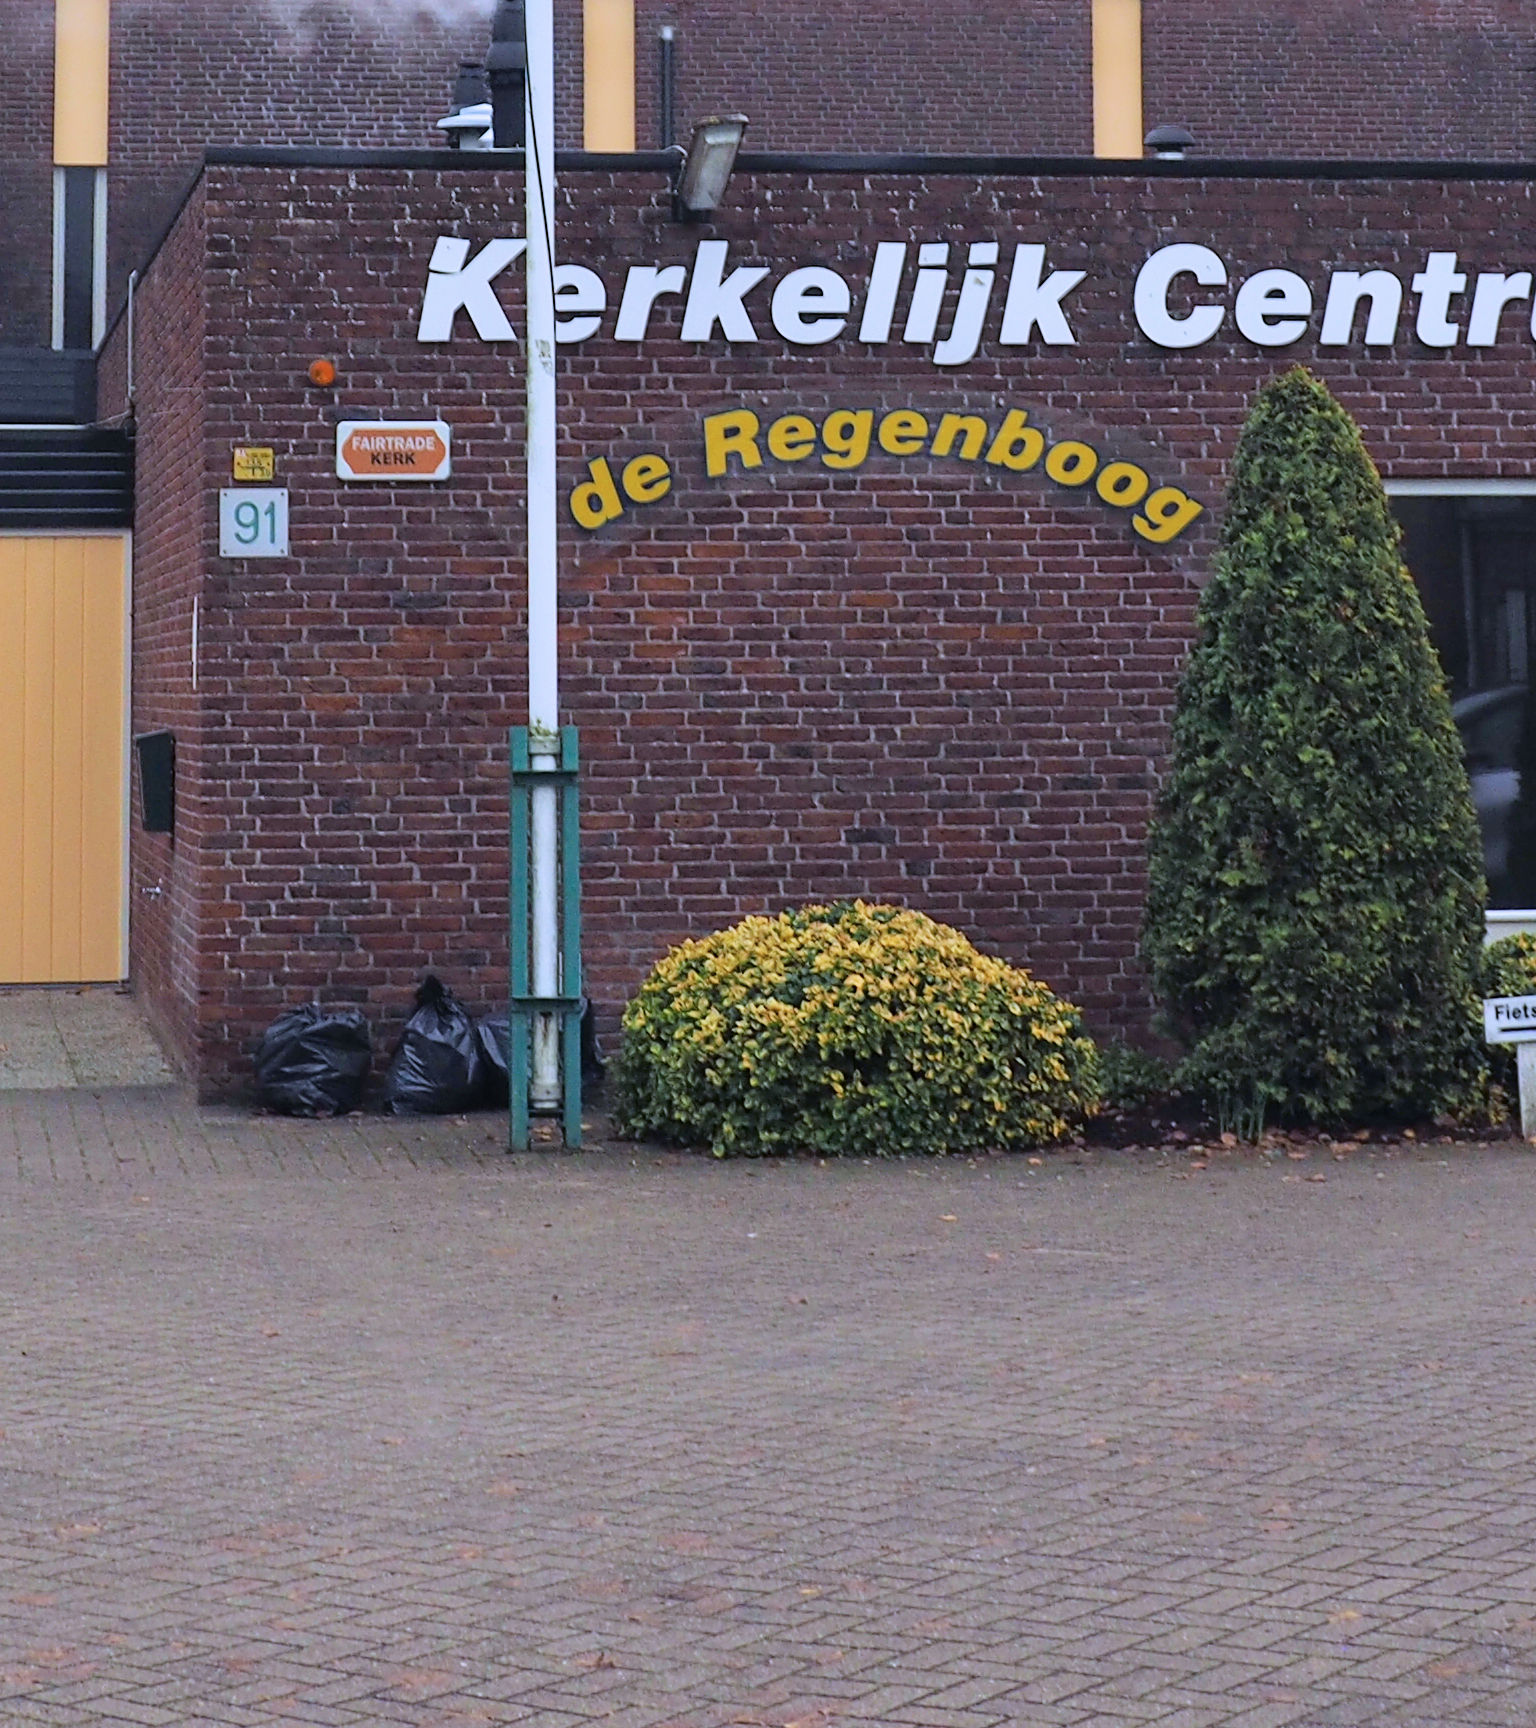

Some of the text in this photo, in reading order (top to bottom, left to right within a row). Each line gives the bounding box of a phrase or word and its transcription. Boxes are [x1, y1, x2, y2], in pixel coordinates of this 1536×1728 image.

[417, 235, 1087, 365] Kerkelijk
[352, 436, 435, 451] FAIRTRADE
[371, 452, 416, 465] KERK
[570, 409, 1204, 543] de Regenboog
[234, 501, 276, 545] 91
